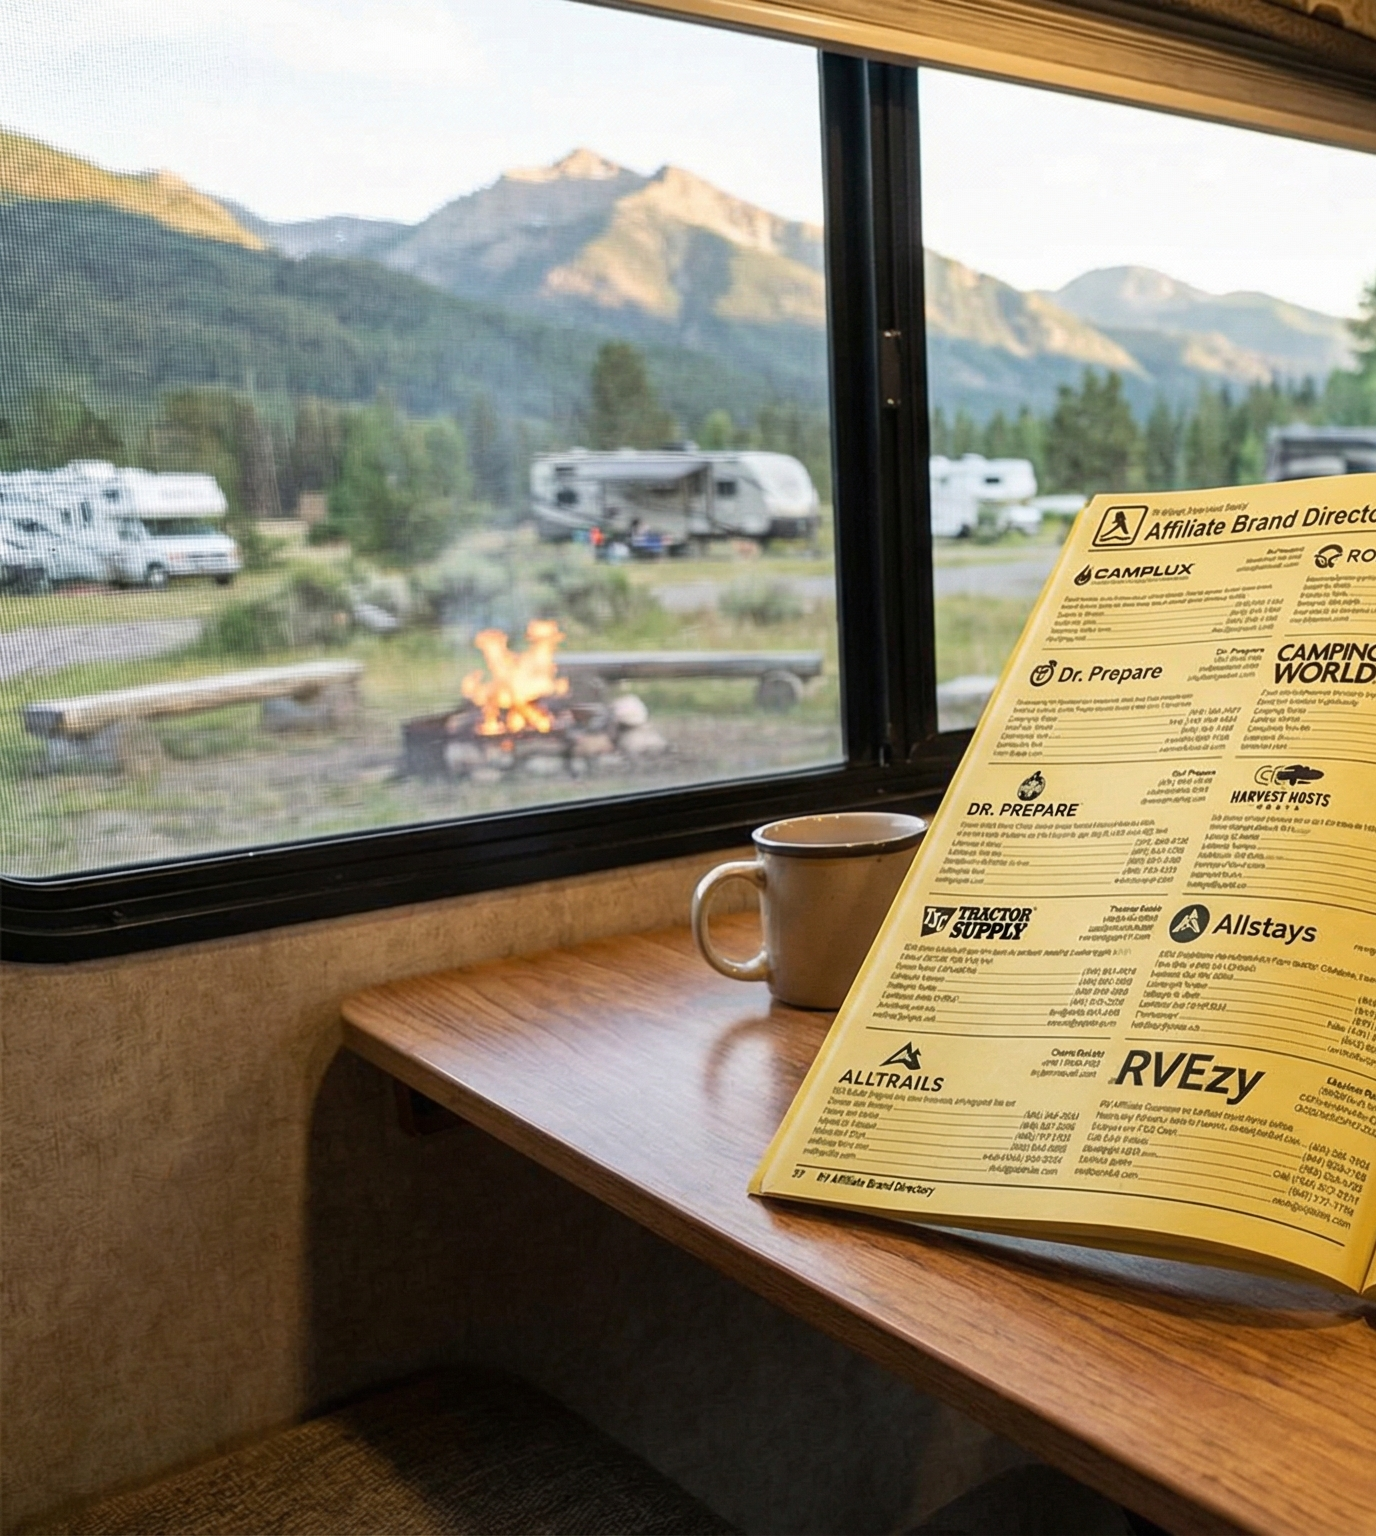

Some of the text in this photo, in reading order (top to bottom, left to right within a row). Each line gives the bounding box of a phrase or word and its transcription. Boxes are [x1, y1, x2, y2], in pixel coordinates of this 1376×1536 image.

[1144, 517, 1226, 541] Affiliate
[1231, 509, 1299, 534] Brand
[1094, 563, 1196, 579] CAMPLUX
[1057, 664, 1163, 685] Dr. Prepare
[1230, 790, 1331, 807] HARVEST HOSTS
[966, 802, 1080, 817] DR. PREPARE
[958, 906, 1033, 922] TRACTOR
[948, 921, 1028, 940] SUPPLY
[1212, 914, 1317, 945] Allstays
[838, 1069, 945, 1092] ALLTRAILS
[1114, 1049, 1267, 1105] RVEzy
